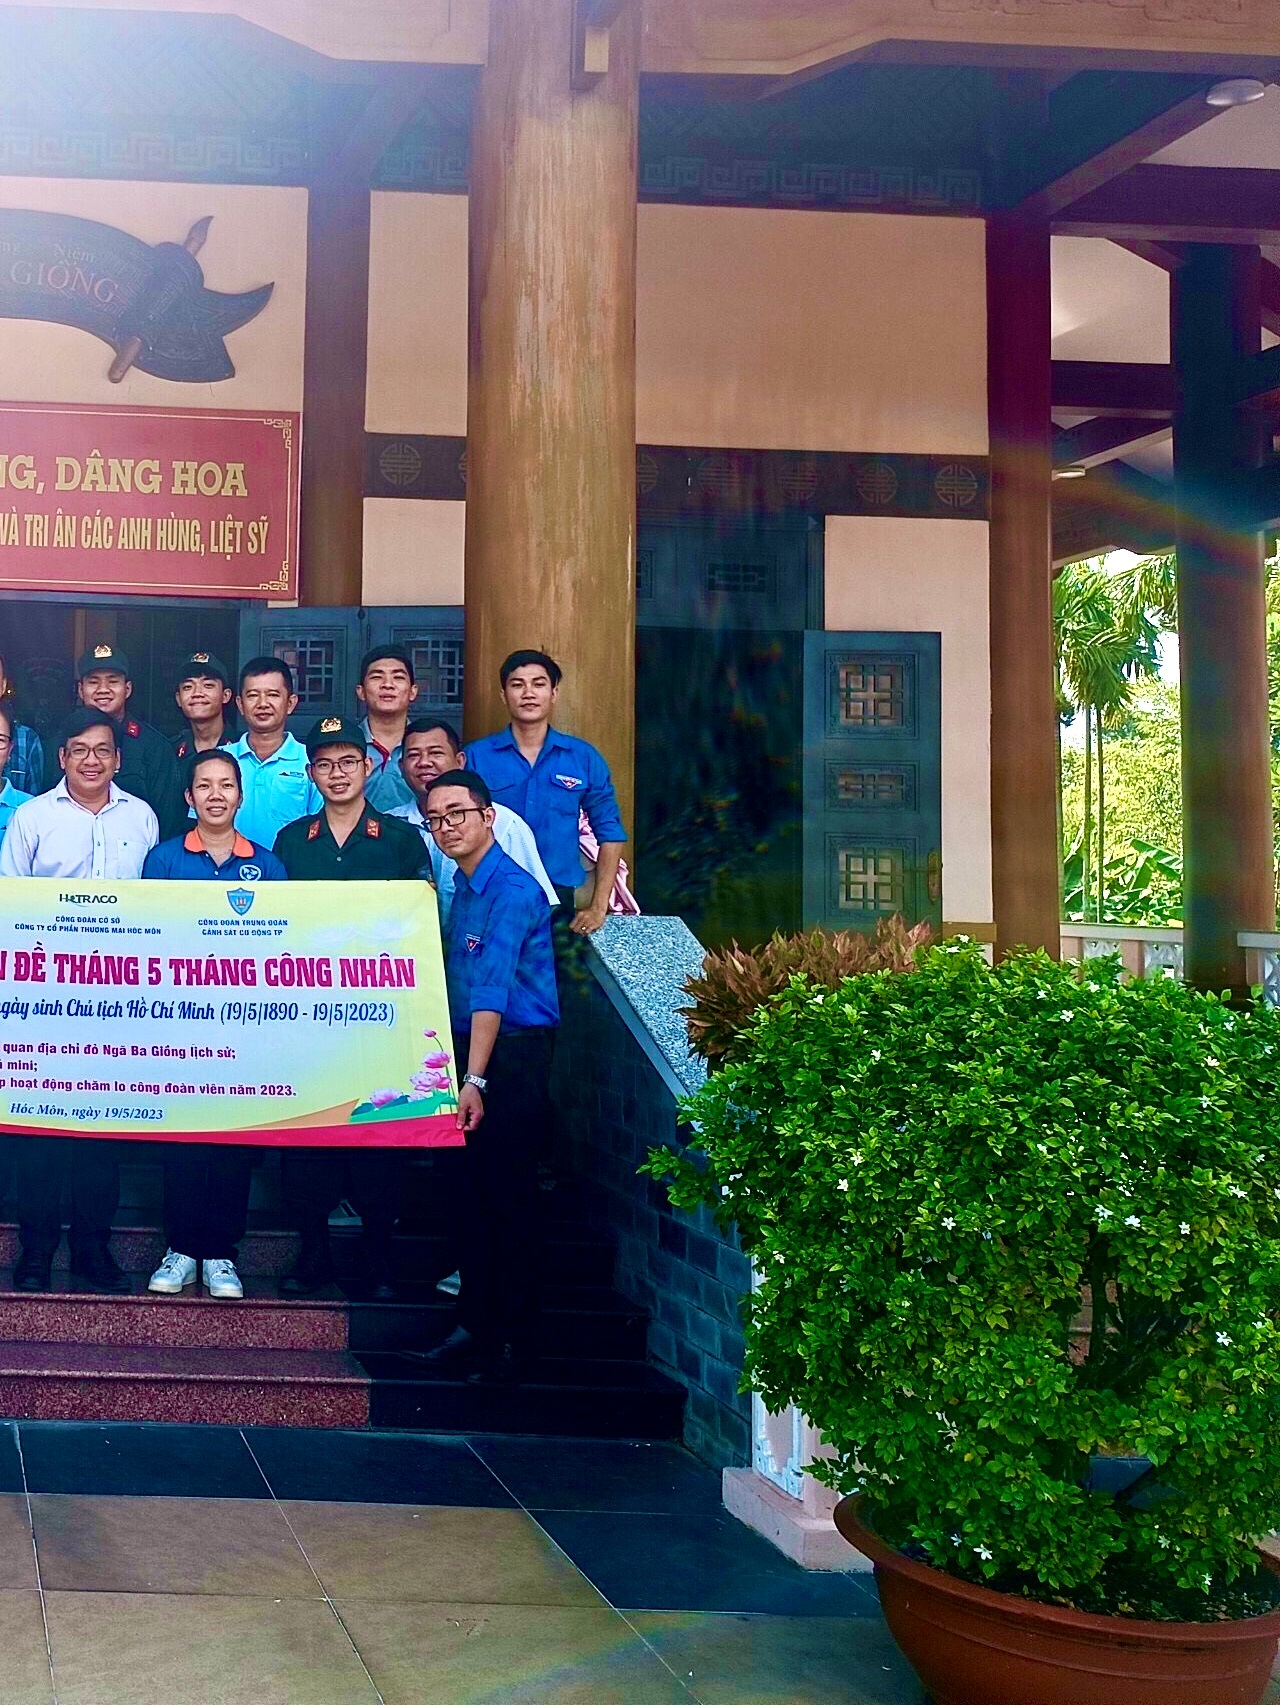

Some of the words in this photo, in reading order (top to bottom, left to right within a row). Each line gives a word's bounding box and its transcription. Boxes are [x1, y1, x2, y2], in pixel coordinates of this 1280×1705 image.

[10, 258, 120, 304] GIỒNG
[55, 449, 163, 494] DÂNG
[171, 460, 248, 497] HOA
[0, 506, 20, 546] VÀ
[24, 513, 49, 547] TRI
[52, 507, 77, 548] ÂN
[81, 509, 114, 550] CÁC
[117, 517, 152, 550] ANH
[156, 511, 206, 557] HÙNG,
[210, 513, 244, 561] LIỆT
[247, 515, 269, 555] SỸ
[14, 923, 35, 931] CÔNG
[13, 941, 46, 983] ĐỀ
[53, 949, 140, 986] THÁNG
[147, 957, 162, 986] 5
[169, 953, 258, 987] THÁNG
[264, 952, 333, 988] CÔNG
[339, 952, 416, 988] NHÂN
[32, 998, 64, 1018] sinh
[66, 998, 95, 1018] Chủ
[96, 1000, 124, 1022] tịch
[126, 996, 150, 1019] Hồ
[150, 999, 174, 1020] Chí
[177, 1001, 216, 1020] Minh
[220, 1001, 299, 1026] (19/5/1890
[312, 1002, 395, 1027] 19/5/2023)
[3, 1043, 34, 1054] quan
[37, 1042, 57, 1055] địa
[103, 1044, 127, 1058] Ngã
[131, 1045, 147, 1056] Ba
[189, 1044, 213, 1060] lịch
[7, 1060, 38, 1072] mini;
[9, 1077, 38, 1090] hoạt
[41, 1078, 72, 1092] động
[76, 1079, 111, 1092] chăm
[114, 1080, 126, 1092] lo
[130, 1081, 160, 1095] công
[164, 1082, 195, 1094] đoàn
[198, 1083, 225, 1095] viên
[229, 1083, 256, 1096] năm
[259, 1084, 297, 1097] 2023.
[10, 1102, 34, 1115] Hóc
[36, 1104, 68, 1117] Môn,
[71, 1105, 102, 1120] ngày
[103, 1107, 164, 1120] 19/5/2023
